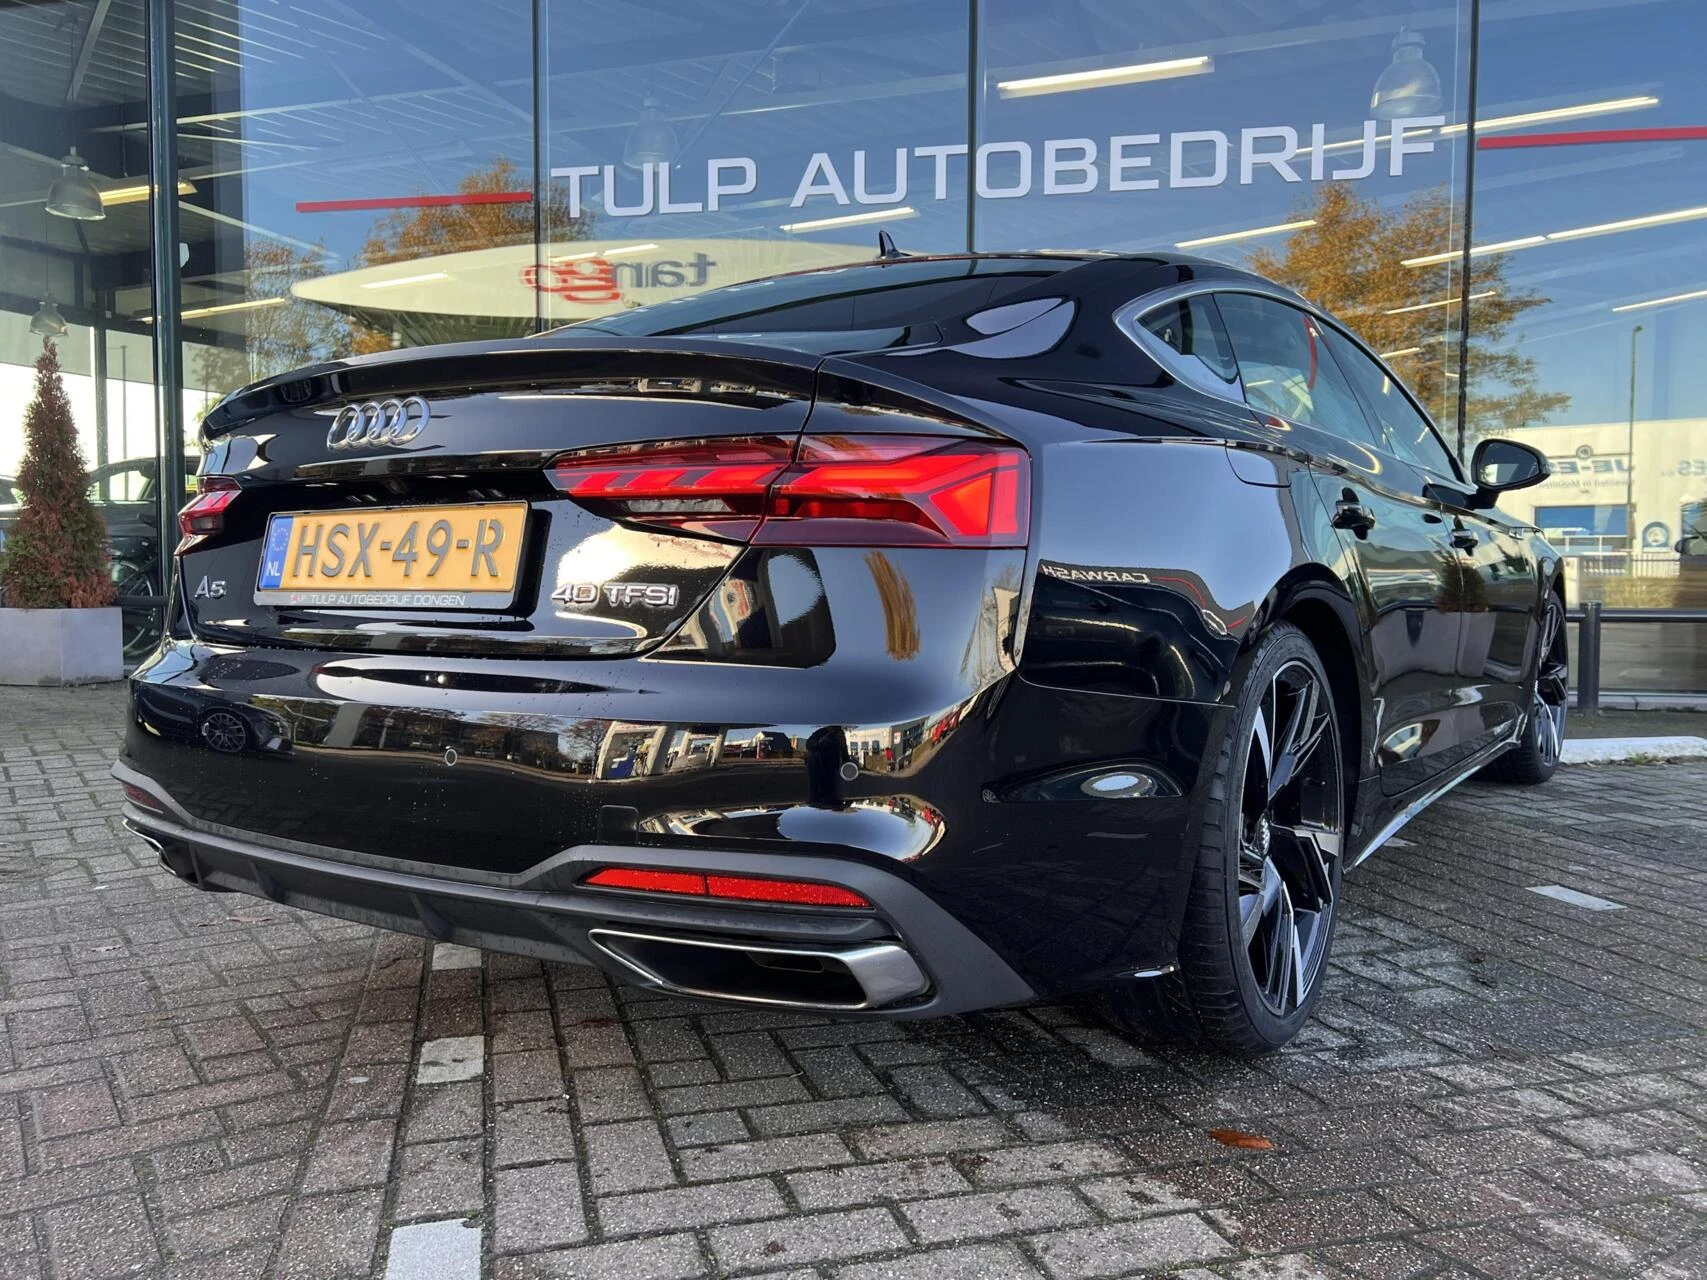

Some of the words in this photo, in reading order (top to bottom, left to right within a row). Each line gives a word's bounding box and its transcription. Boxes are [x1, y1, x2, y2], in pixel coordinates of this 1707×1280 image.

[550, 156, 757, 218] TULP
[790, 115, 1446, 208] AUTOBEDRIJF
[292, 518, 505, 578] HSX-49-R
[266, 561, 281, 576] NL
[194, 575, 227, 598] A5
[551, 584, 598, 604] 40
[603, 583, 679, 607] TFSI
[311, 594, 336, 605] TULP
[337, 594, 411, 605] AUTOBEDRIJF
[413, 594, 467, 606] DONGEN
